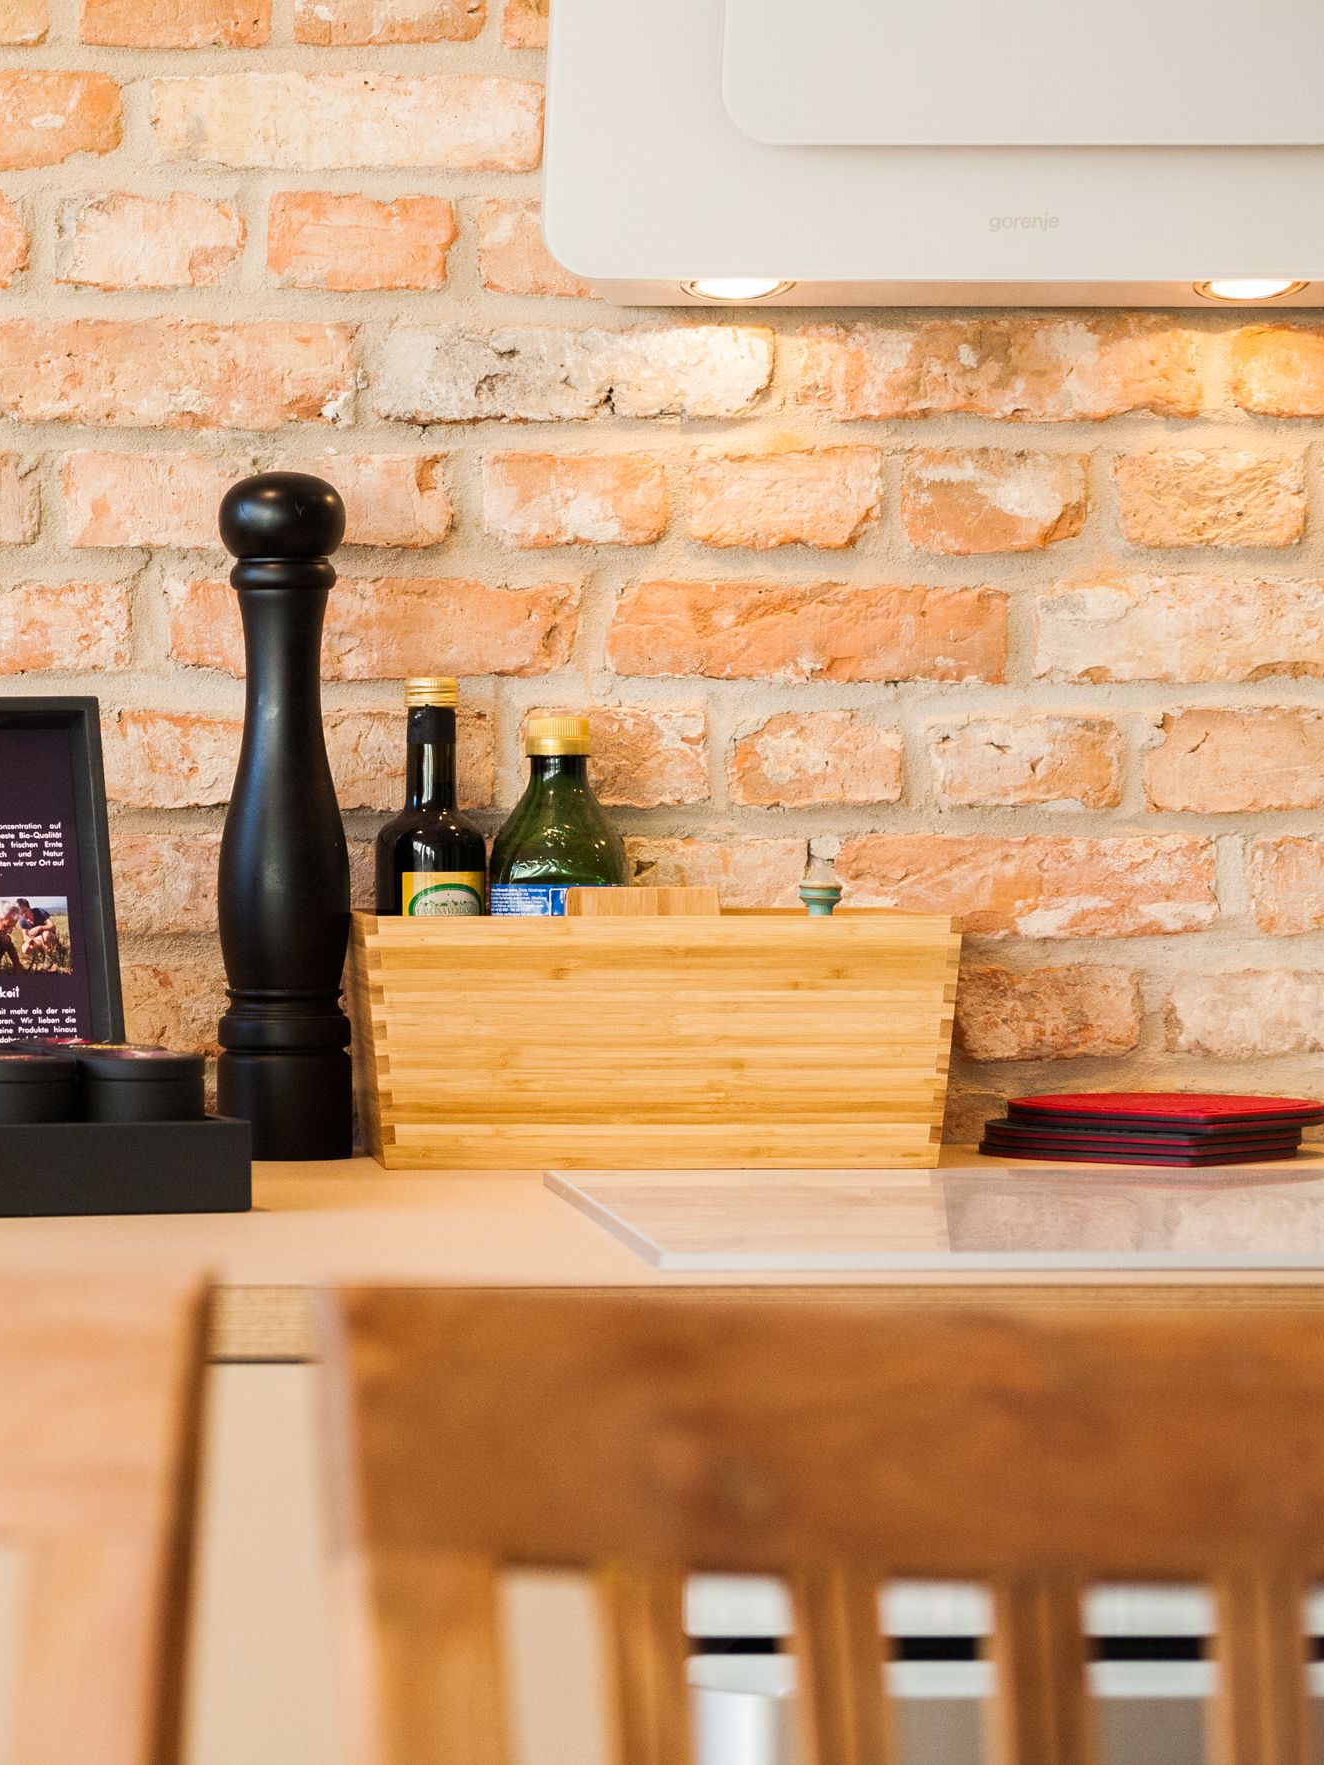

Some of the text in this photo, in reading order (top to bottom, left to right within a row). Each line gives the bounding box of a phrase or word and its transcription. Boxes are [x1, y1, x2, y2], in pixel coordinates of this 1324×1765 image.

[989, 212, 1060, 232] gorenje
[18, 831, 62, 839] Bio-Qualität
[10, 841, 38, 849] frischen
[18, 850, 32, 858] und
[43, 850, 64, 858] Natur
[38, 859, 51, 867] Ort
[9, 1007, 29, 1015] mehr
[32, 1007, 43, 1015] als
[45, 1007, 58, 1015] der
[20, 1017, 33, 1025] Wir
[38, 1016, 60, 1024] lieben
[65, 1016, 77, 1024] die
[18, 1026, 49, 1034] Produkte
